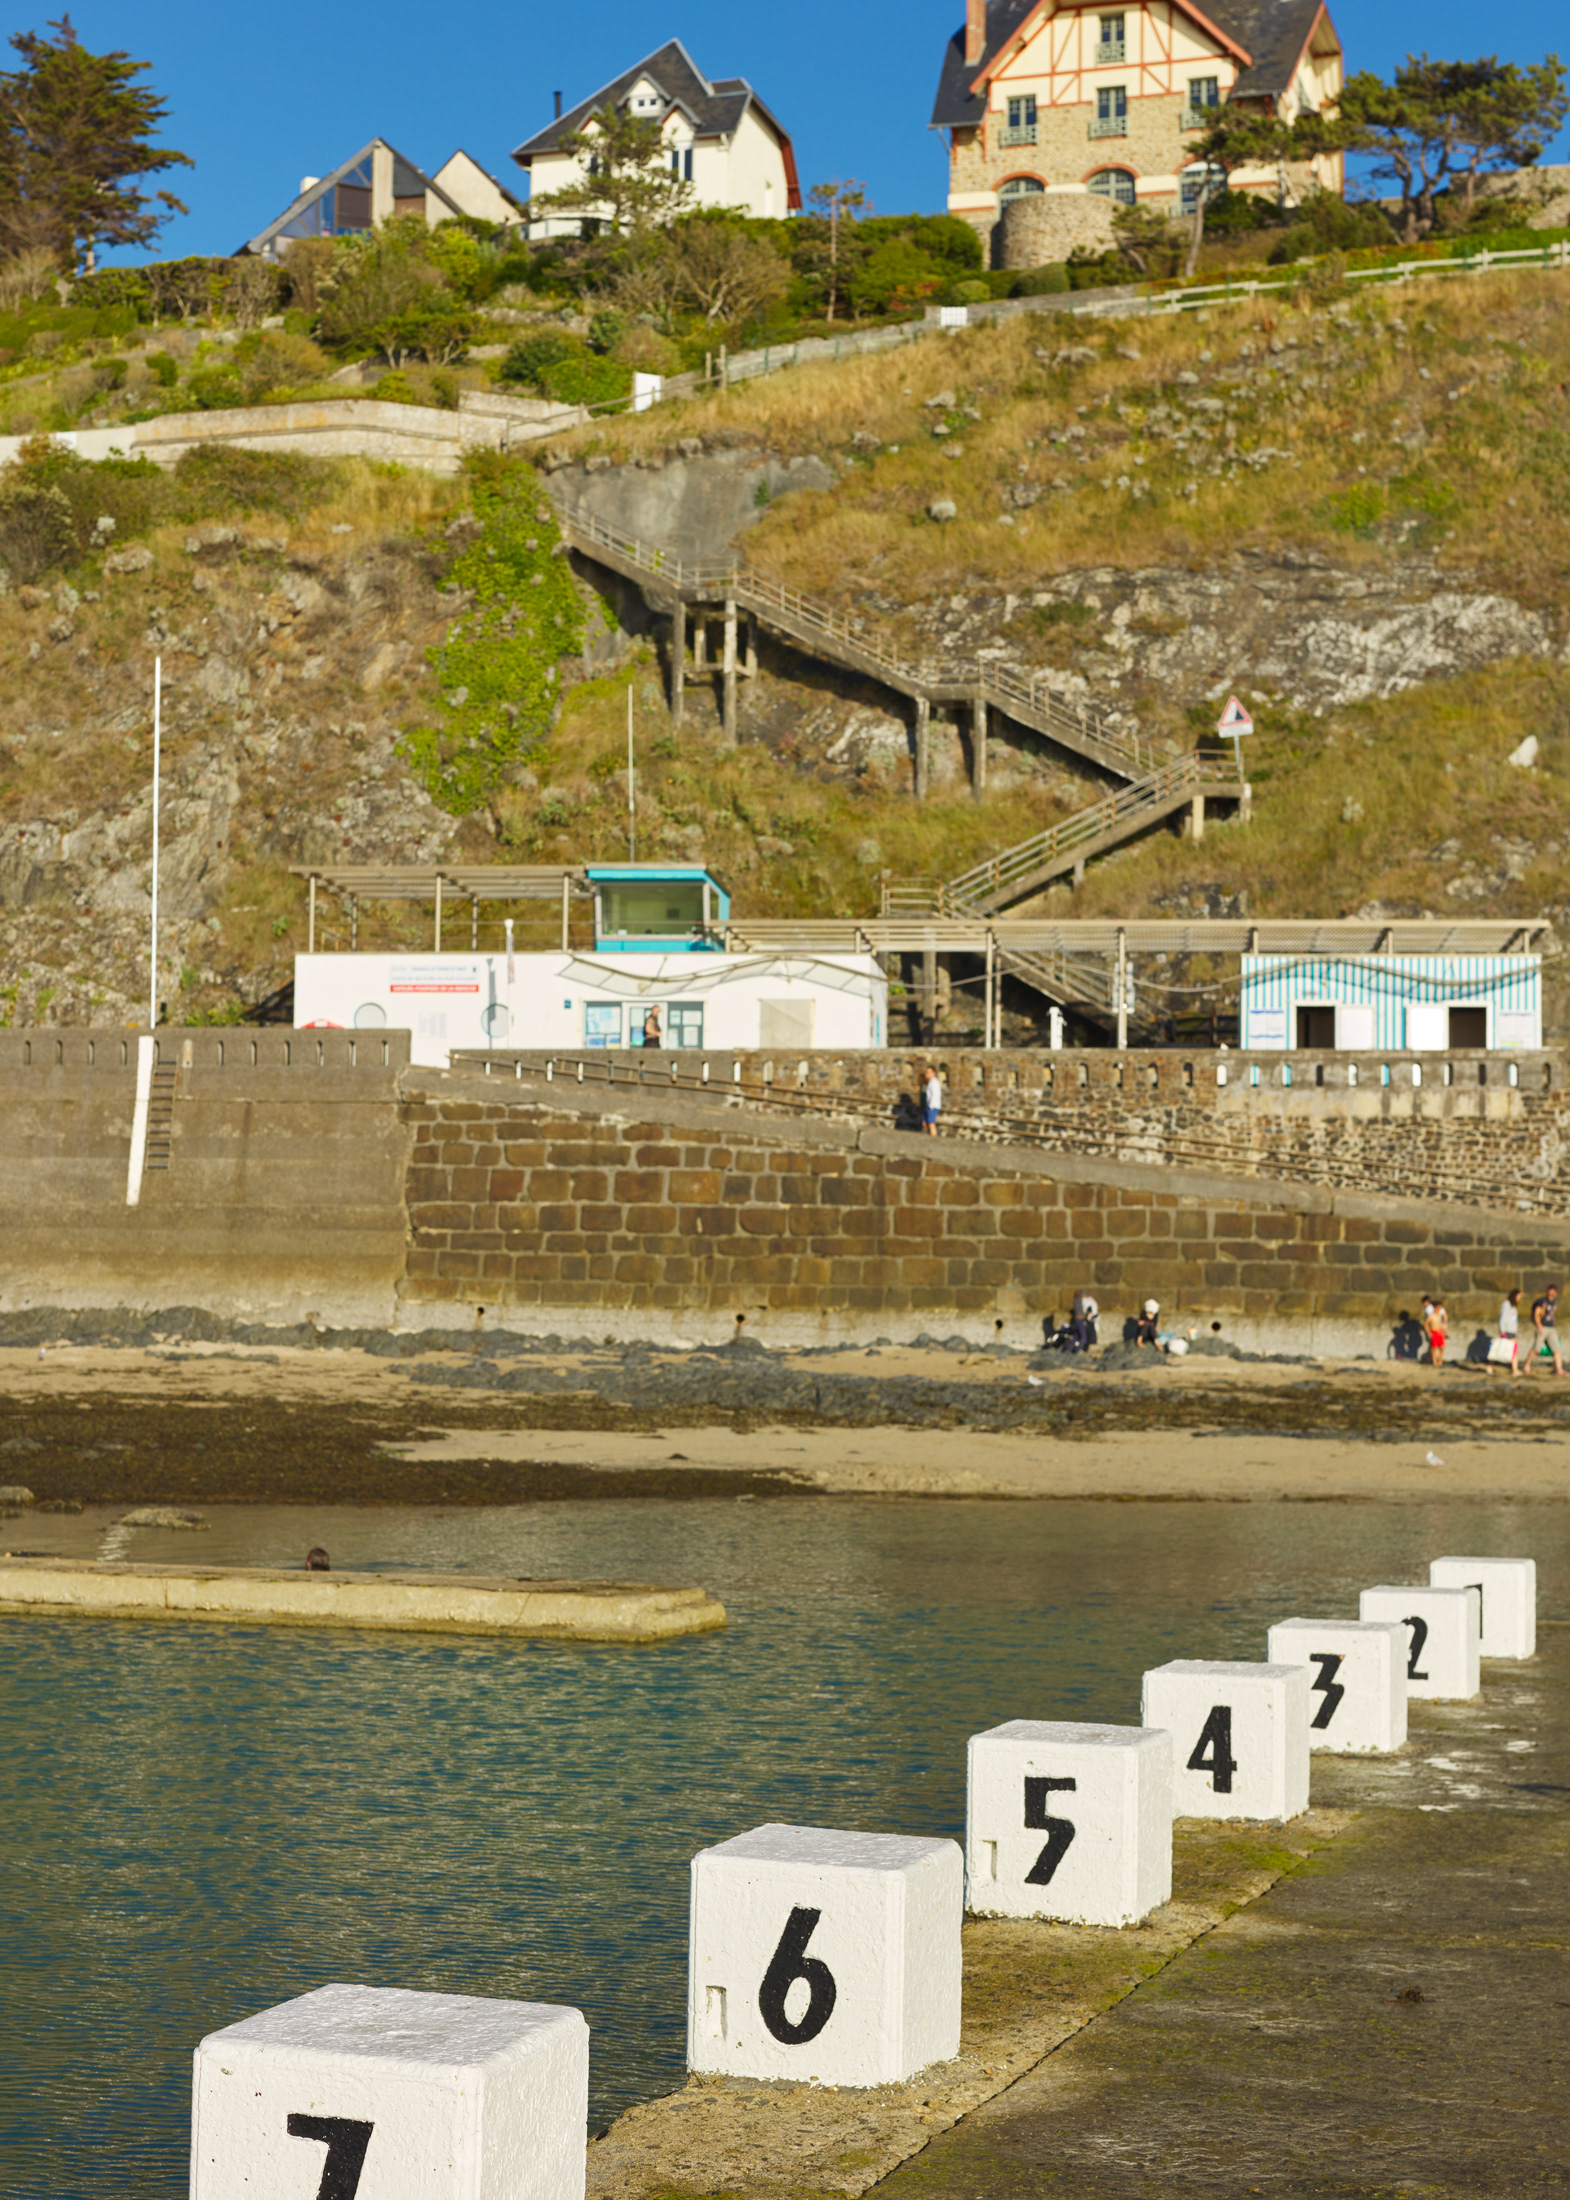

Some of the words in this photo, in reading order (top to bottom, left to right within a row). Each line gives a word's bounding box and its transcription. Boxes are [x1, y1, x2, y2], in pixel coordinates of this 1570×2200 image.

[1309, 1653, 1345, 1730] 3
[1401, 1616, 1429, 1680] 2
[1186, 1705, 1238, 1794] 4
[1024, 1776, 1077, 1886] 5
[758, 1906, 837, 2045] 6
[286, 2112, 375, 2200] 7
